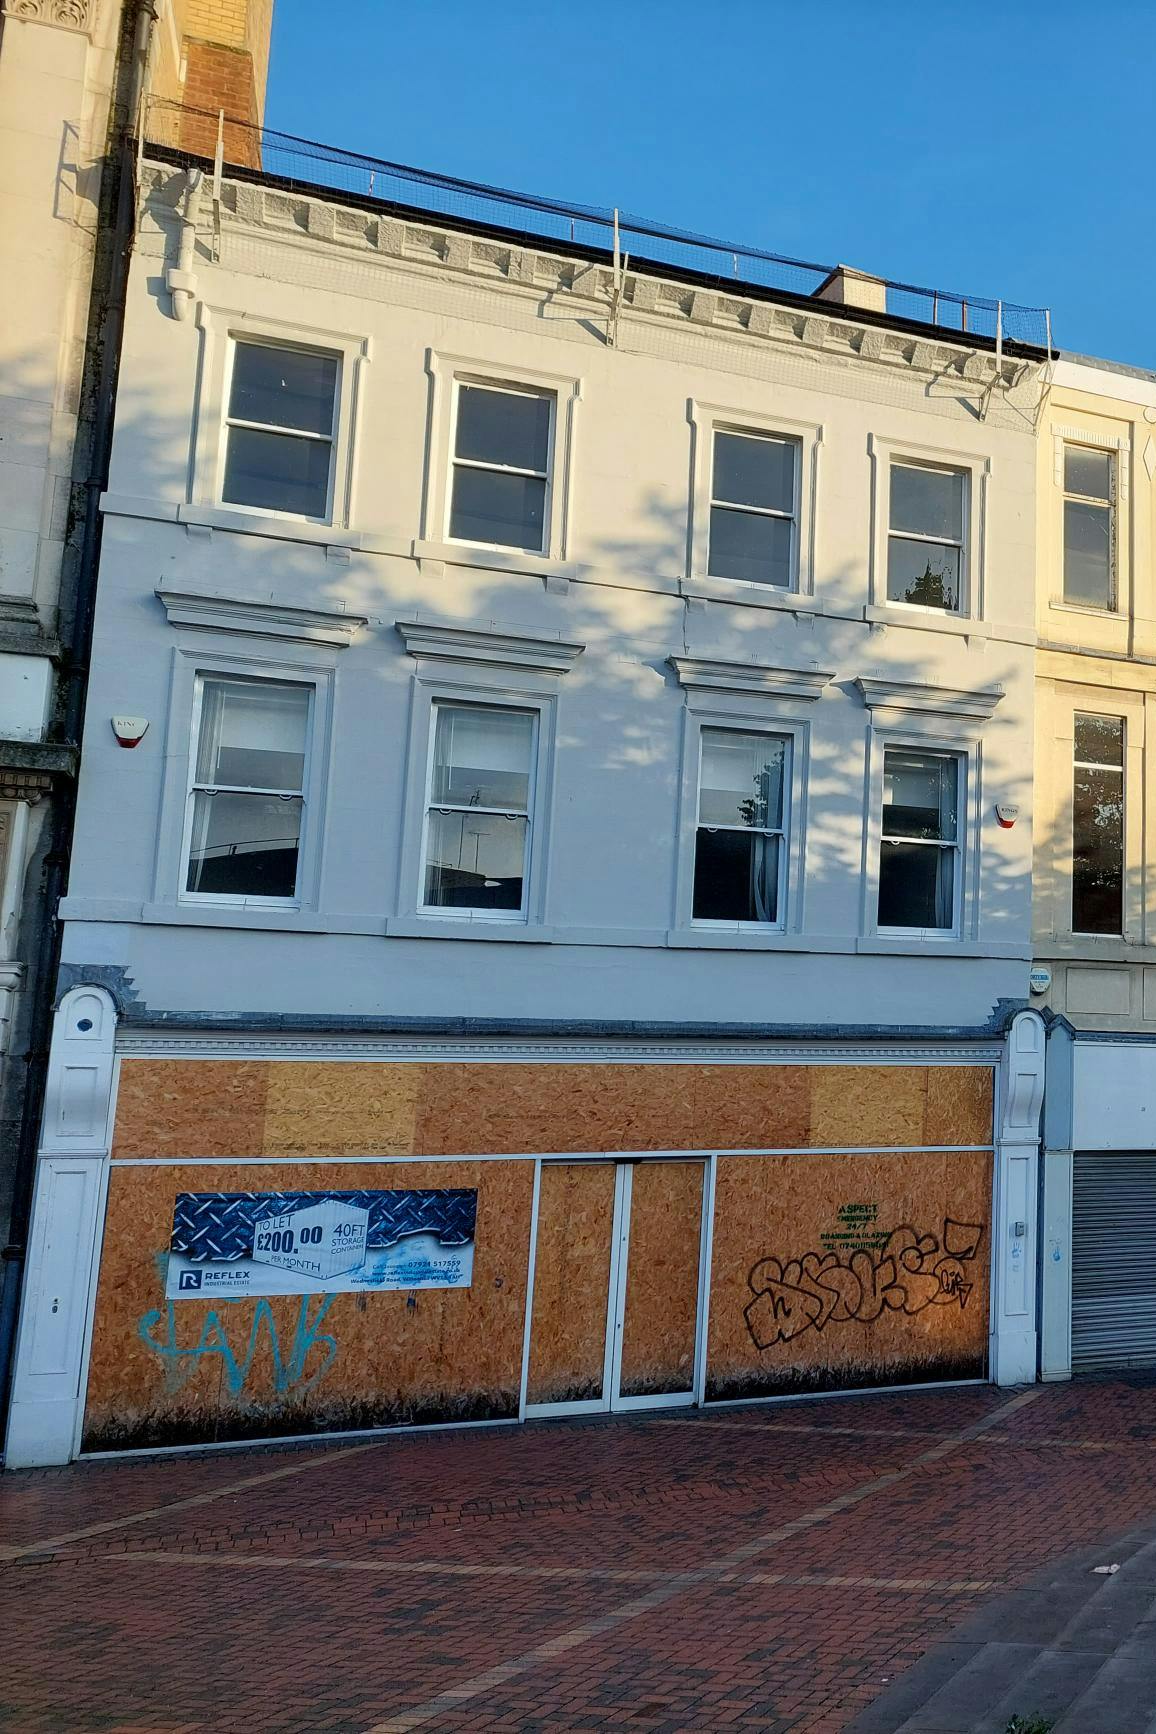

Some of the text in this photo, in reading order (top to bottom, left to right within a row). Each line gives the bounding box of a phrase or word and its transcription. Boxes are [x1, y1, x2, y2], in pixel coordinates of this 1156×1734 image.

[838, 1204, 878, 1213] ASPECT
[258, 1213, 295, 1231] TO LET
[333, 1223, 365, 1237] 40FT
[331, 1236, 364, 1247] STORAGE
[271, 1254, 321, 1272] PER MONTH
[205, 1271, 250, 1280] REFLEX
